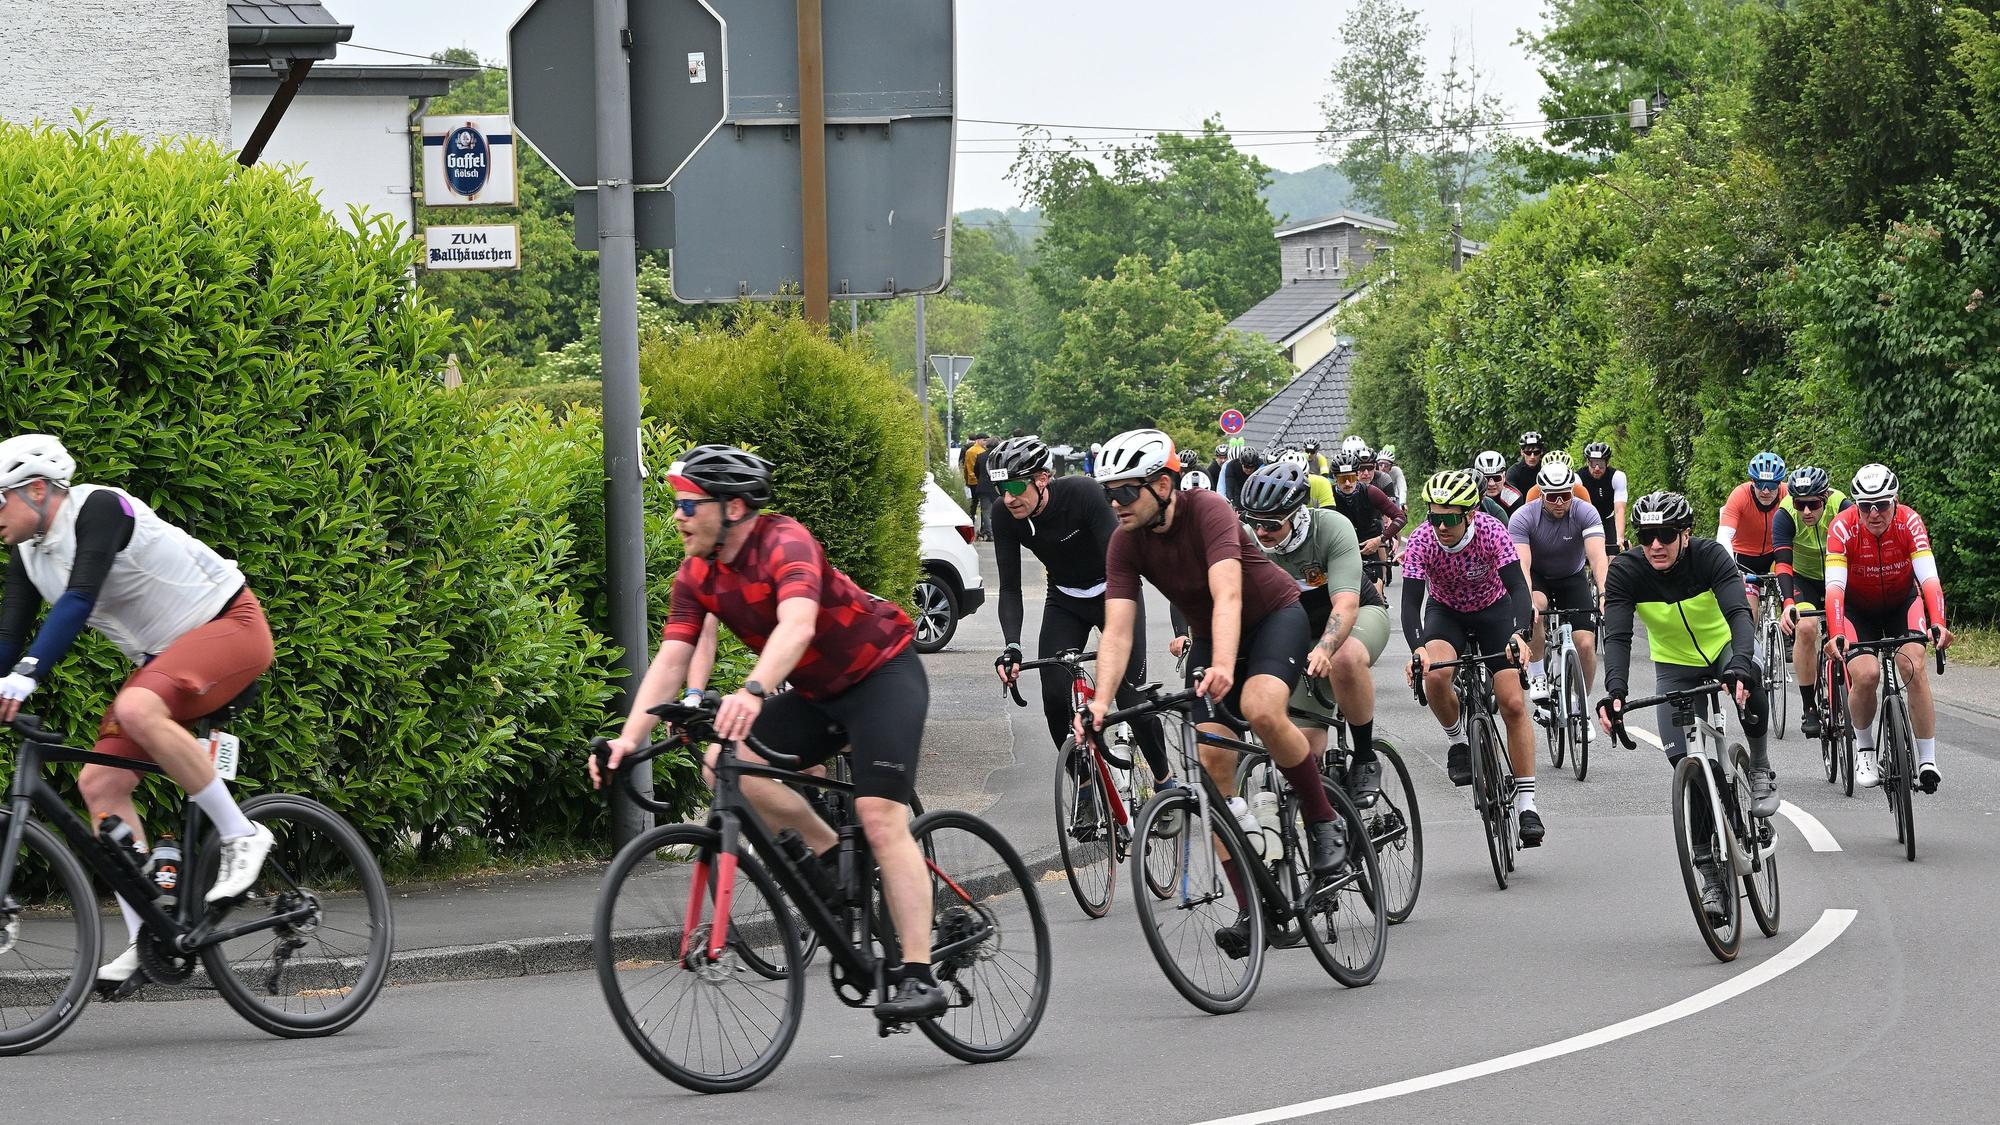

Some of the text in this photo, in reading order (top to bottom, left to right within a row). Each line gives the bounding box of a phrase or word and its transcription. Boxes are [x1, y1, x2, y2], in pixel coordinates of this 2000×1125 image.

[447, 153, 486, 169] Gaffel
[454, 169, 479, 178] Kölsch
[451, 233, 488, 245] ZUM
[429, 248, 513, 264] Ballhäuschen
[1642, 513, 1660, 522] 6320
[1886, 659, 1896, 691] GIANT
